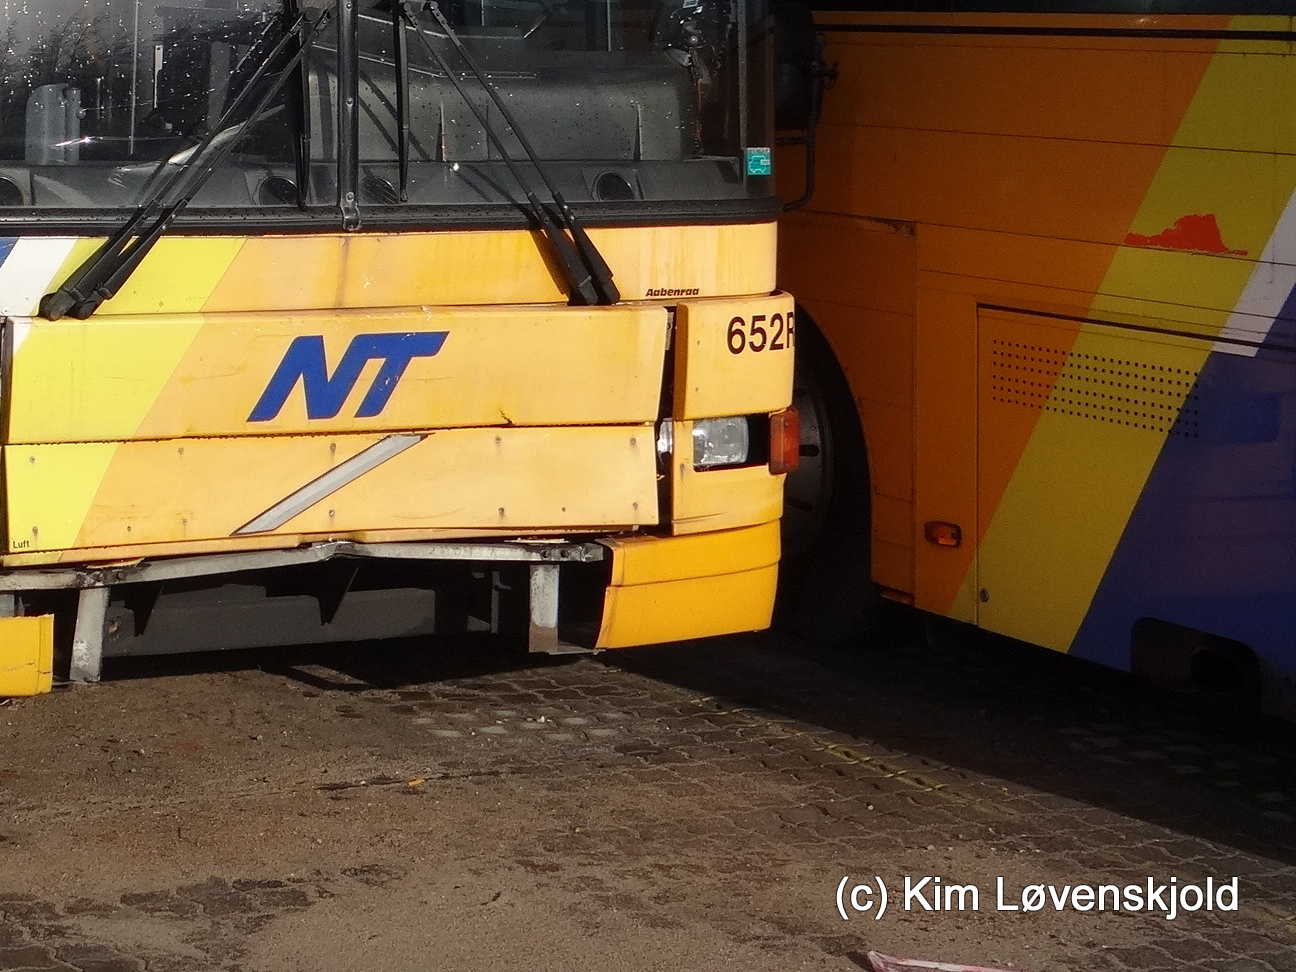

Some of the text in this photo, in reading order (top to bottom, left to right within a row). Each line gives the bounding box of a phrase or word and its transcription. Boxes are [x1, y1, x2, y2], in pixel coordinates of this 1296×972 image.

[645, 288, 700, 297] Aabenraa
[245, 330, 451, 422] NT
[12, 540, 30, 549] Luft
